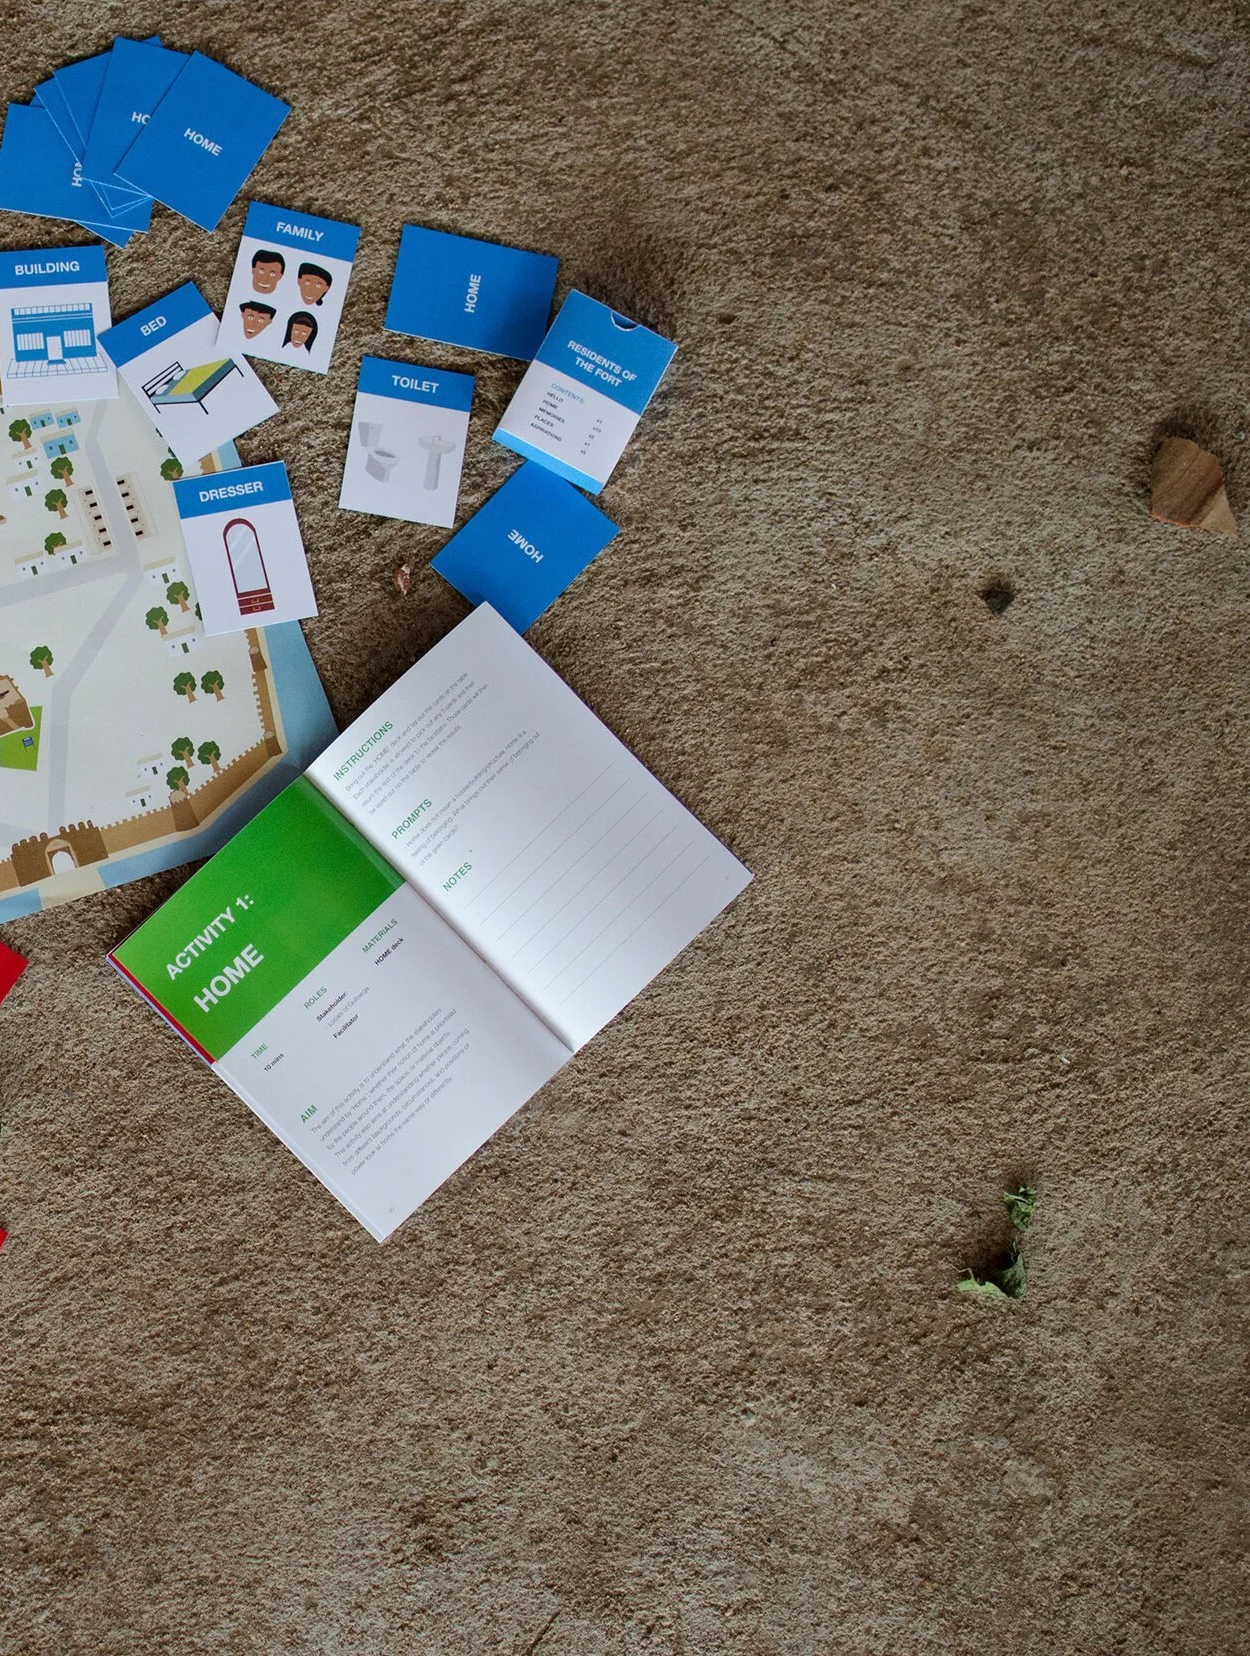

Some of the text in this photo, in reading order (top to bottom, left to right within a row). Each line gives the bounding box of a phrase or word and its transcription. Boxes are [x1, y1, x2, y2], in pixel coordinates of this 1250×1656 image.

[131, 111, 151, 125] HO
[184, 128, 222, 155] HOME
[277, 222, 323, 241] FAMILY
[15, 261, 79, 275] BUILDING
[464, 274, 481, 312] HOME
[141, 316, 166, 336] BED
[566, 339, 637, 381] RESIDENTS OF
[575, 356, 623, 387] THE FORT
[392, 376, 439, 392] TOILET
[542, 398, 558, 410] HOME
[546, 391, 563, 403] HELLO
[533, 414, 554, 427] PLACES
[537, 406, 565, 423] MEMORIES
[529, 422, 562, 442] ASPIRATIONS
[199, 481, 263, 502] DRESSER
[508, 530, 543, 563] HOME
[332, 721, 393, 781] INSTRUCTIONS
[390, 798, 432, 840] PROMPTS
[443, 862, 472, 892] NOTES
[166, 895, 255, 981] ACTIVITY 1:
[360, 918, 398, 954] MATERIALS
[373, 937, 405, 967] HOME deck
[193, 943, 265, 1013] HOME
[303, 986, 327, 1010] ROLES
[315, 989, 350, 1022] Stakeholder:
[326, 985, 370, 1028] Locals of Gulbarga
[332, 1012, 359, 1040] Facilitator
[250, 1042, 269, 1060] TIME
[263, 1052, 285, 1072] 10 mins
[300, 1103, 319, 1124] AIM
